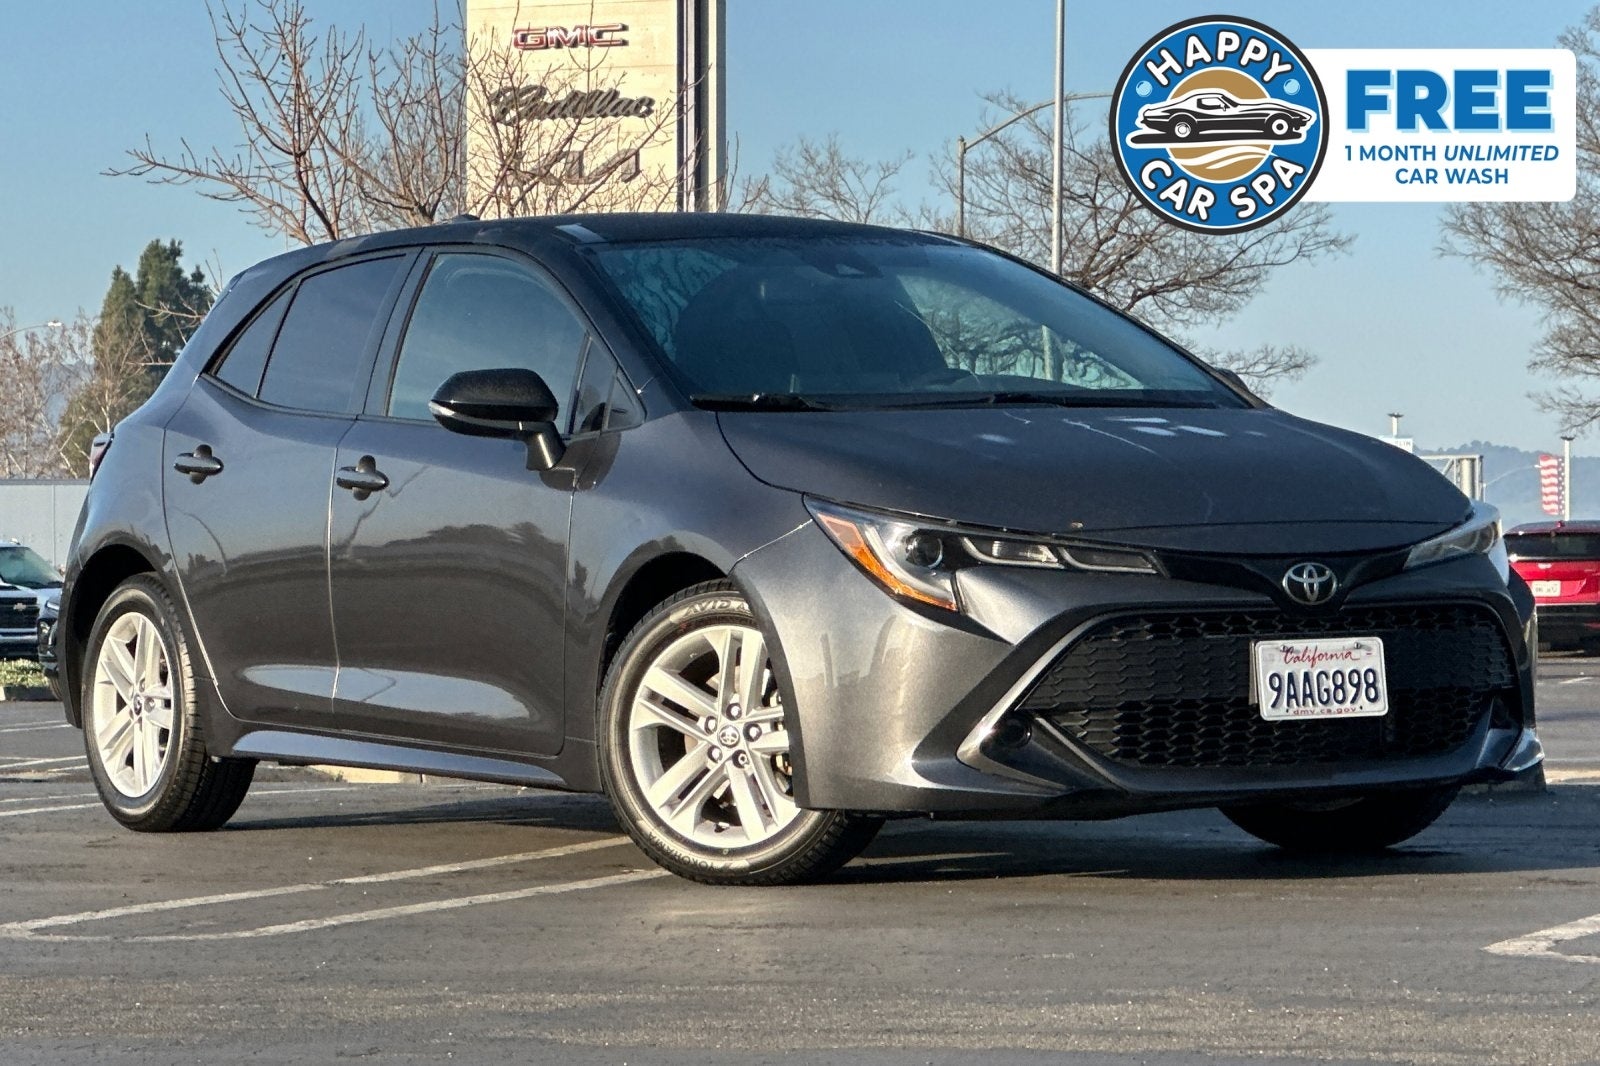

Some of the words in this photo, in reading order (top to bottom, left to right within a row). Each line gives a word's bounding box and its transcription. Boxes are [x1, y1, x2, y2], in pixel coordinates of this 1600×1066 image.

[513, 23, 629, 50] GMC
[490, 84, 655, 126] Cadillac
[1283, 645, 1360, 668] California
[1268, 668, 1379, 708] 9AAG898
